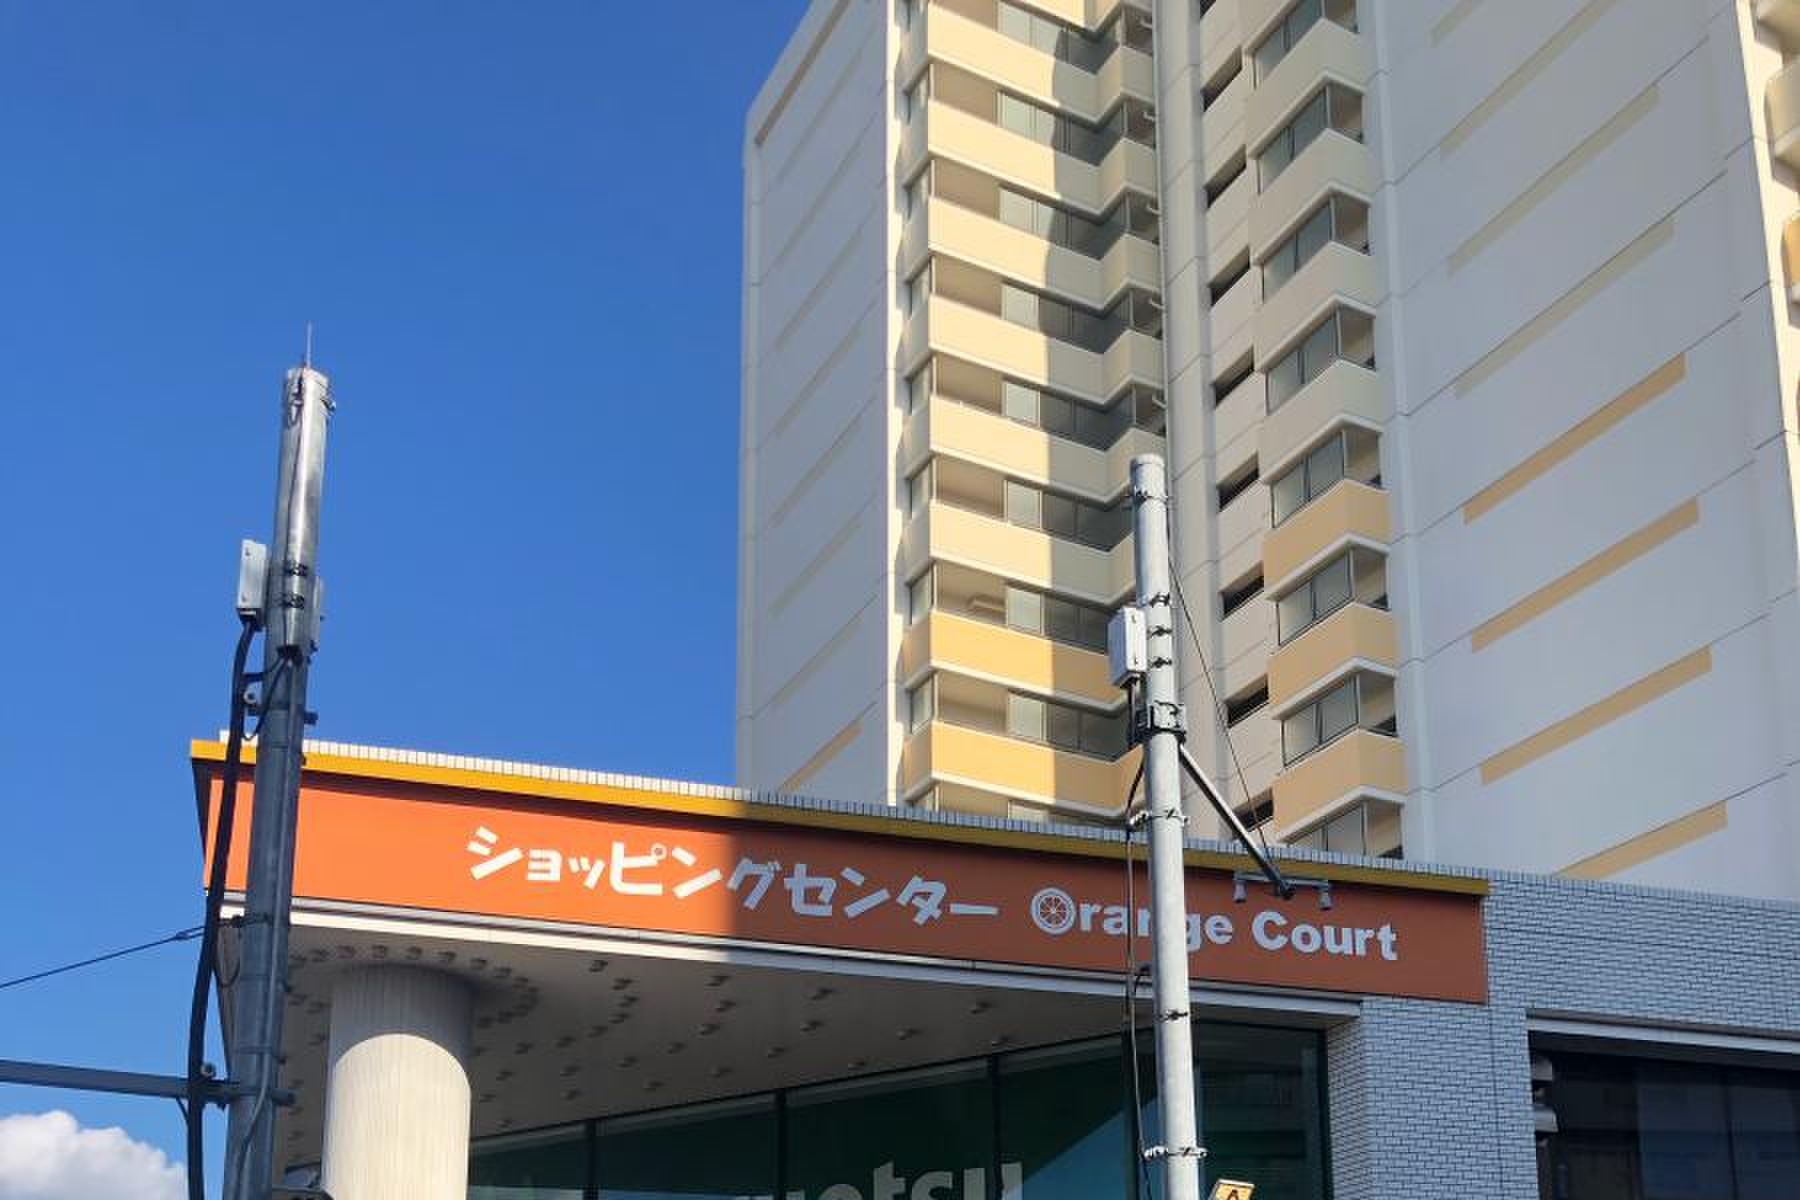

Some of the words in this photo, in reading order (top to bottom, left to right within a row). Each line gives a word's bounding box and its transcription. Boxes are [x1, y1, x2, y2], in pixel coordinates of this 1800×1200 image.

[466, 826, 998, 925] ショッピングセンター
[1252, 910, 1398, 961] Court
